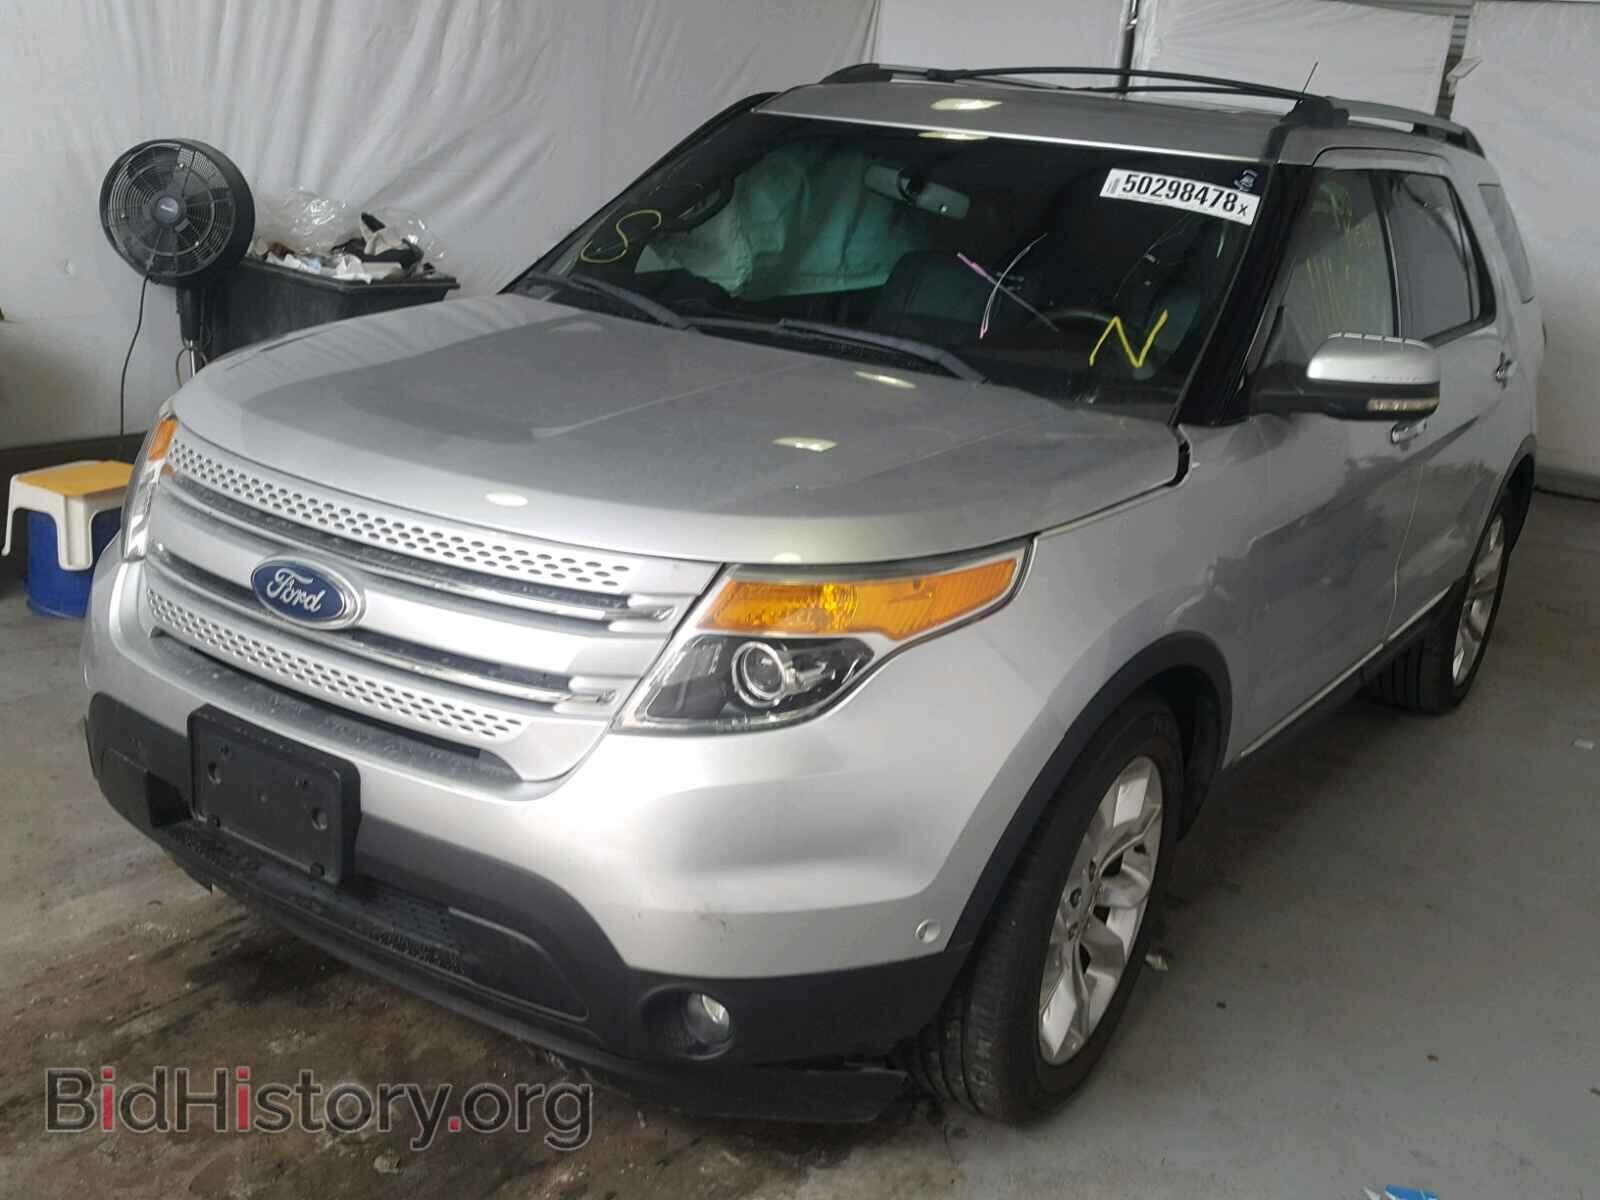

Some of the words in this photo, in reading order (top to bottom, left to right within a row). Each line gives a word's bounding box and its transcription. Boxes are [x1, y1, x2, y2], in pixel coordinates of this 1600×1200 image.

[1122, 174, 1238, 212] 50298478
[1089, 308, 1168, 368] N
[266, 567, 326, 613] Ford
